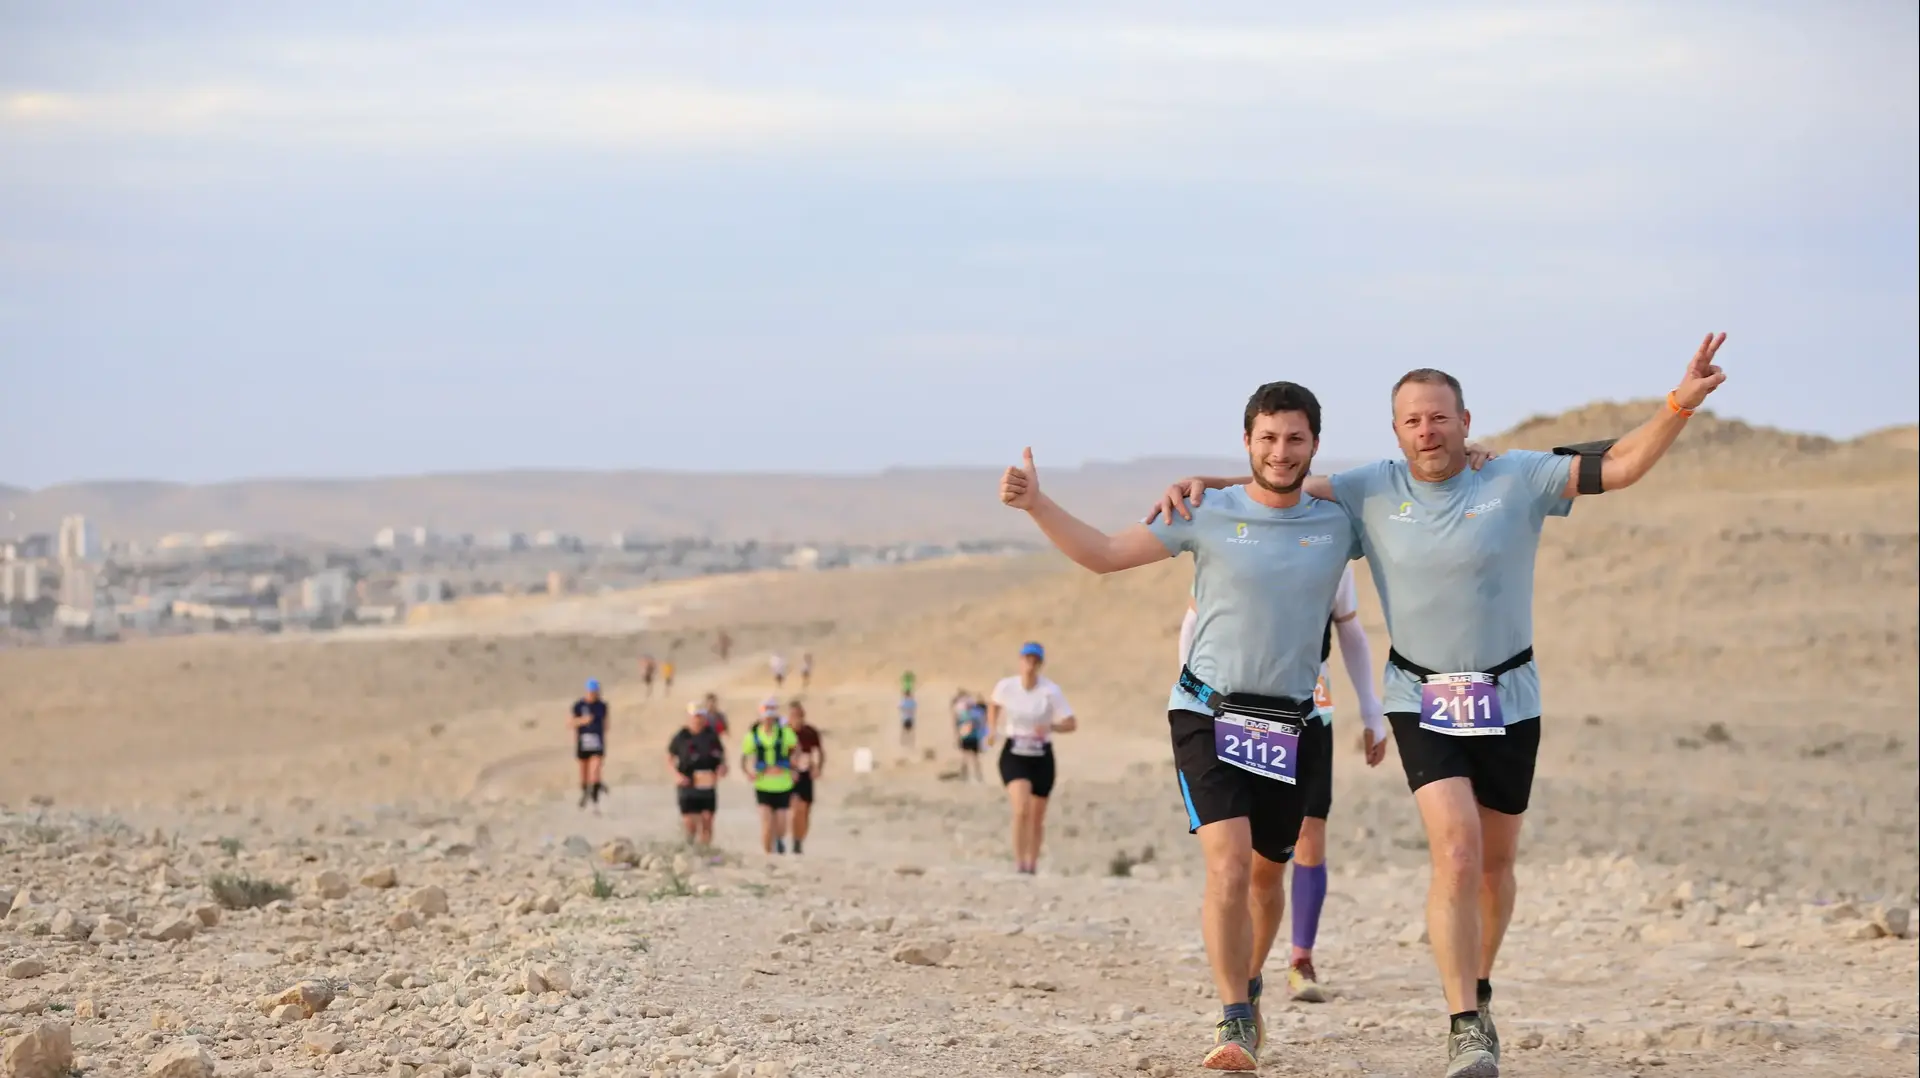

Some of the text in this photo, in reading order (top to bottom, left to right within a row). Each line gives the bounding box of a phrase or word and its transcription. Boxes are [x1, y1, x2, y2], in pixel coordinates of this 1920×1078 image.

[1431, 695, 1491, 721] 2111
[1245, 719, 1269, 730] DMR
[1224, 734, 1287, 769] 2112
